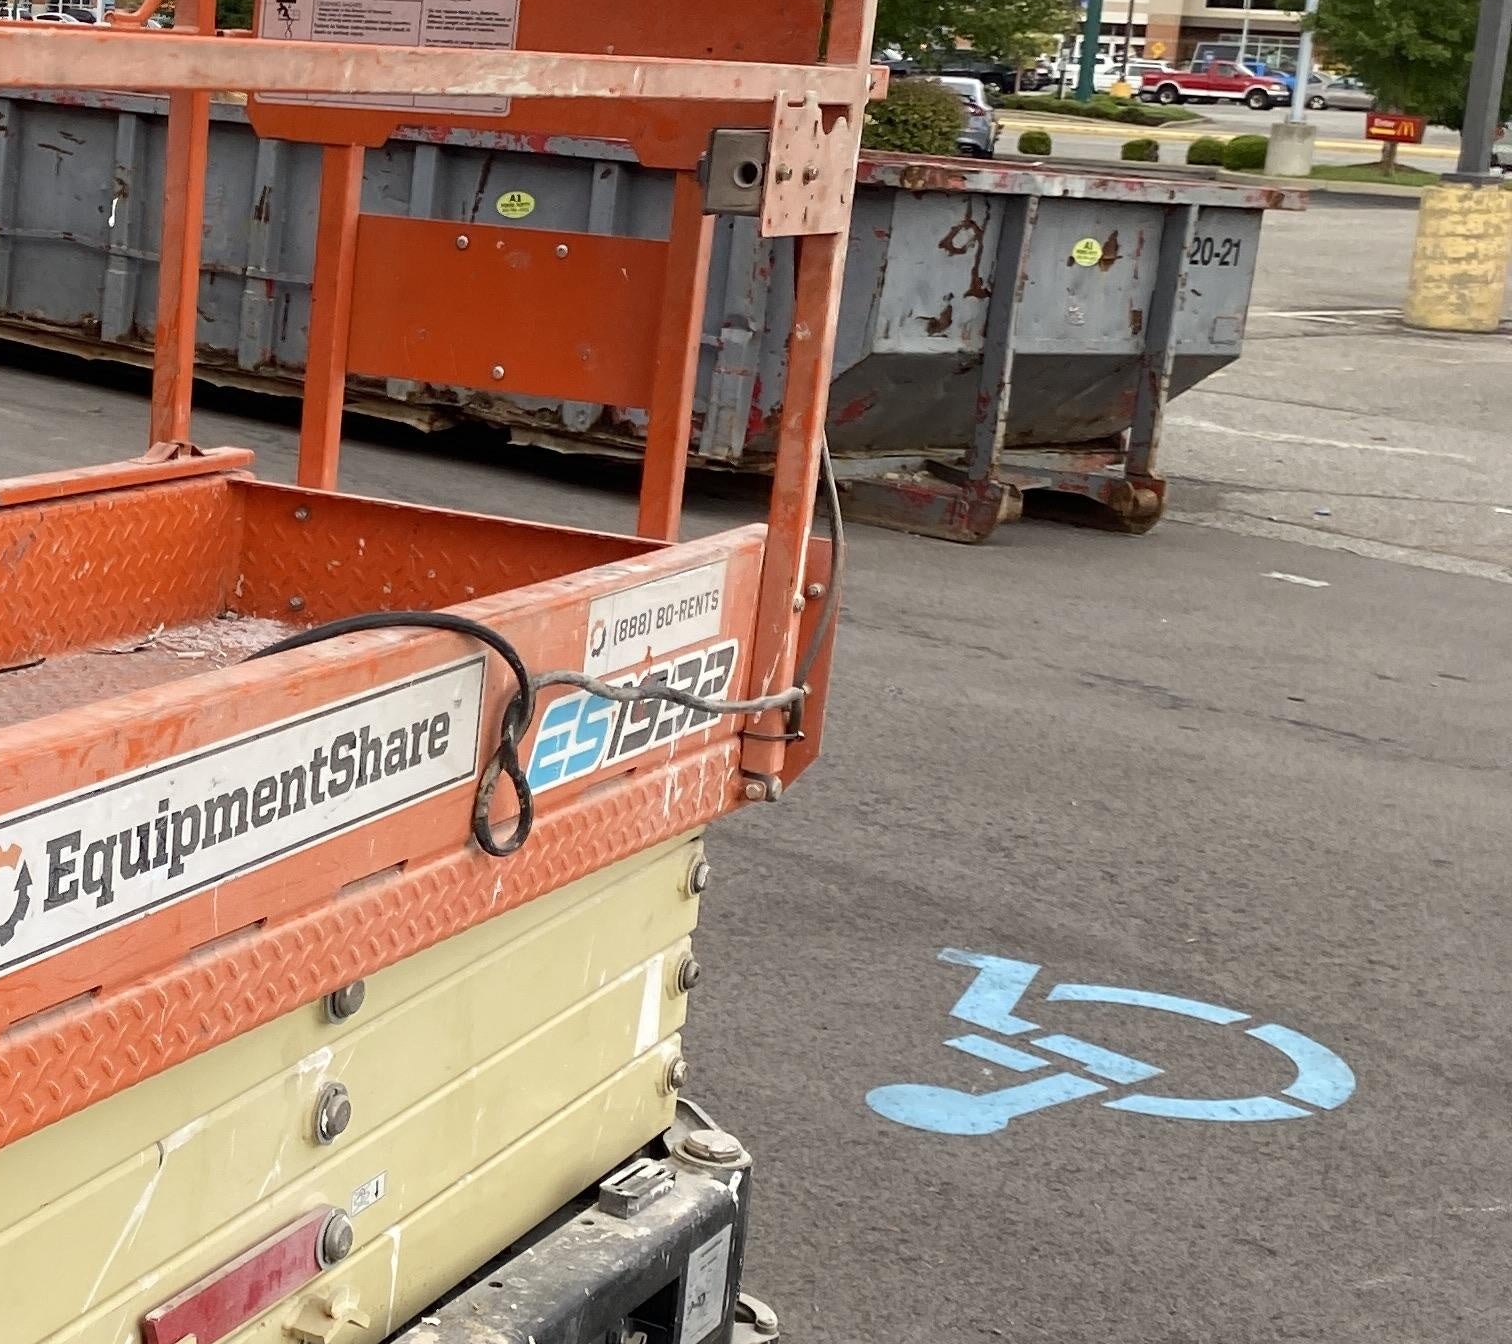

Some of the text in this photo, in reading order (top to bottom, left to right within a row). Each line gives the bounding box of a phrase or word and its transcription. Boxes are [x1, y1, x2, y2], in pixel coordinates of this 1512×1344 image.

[1189, 237, 1241, 266] 20-21
[613, 589, 719, 646] (888) 80-RENTS
[43, 711, 450, 912] EquipmentShare
